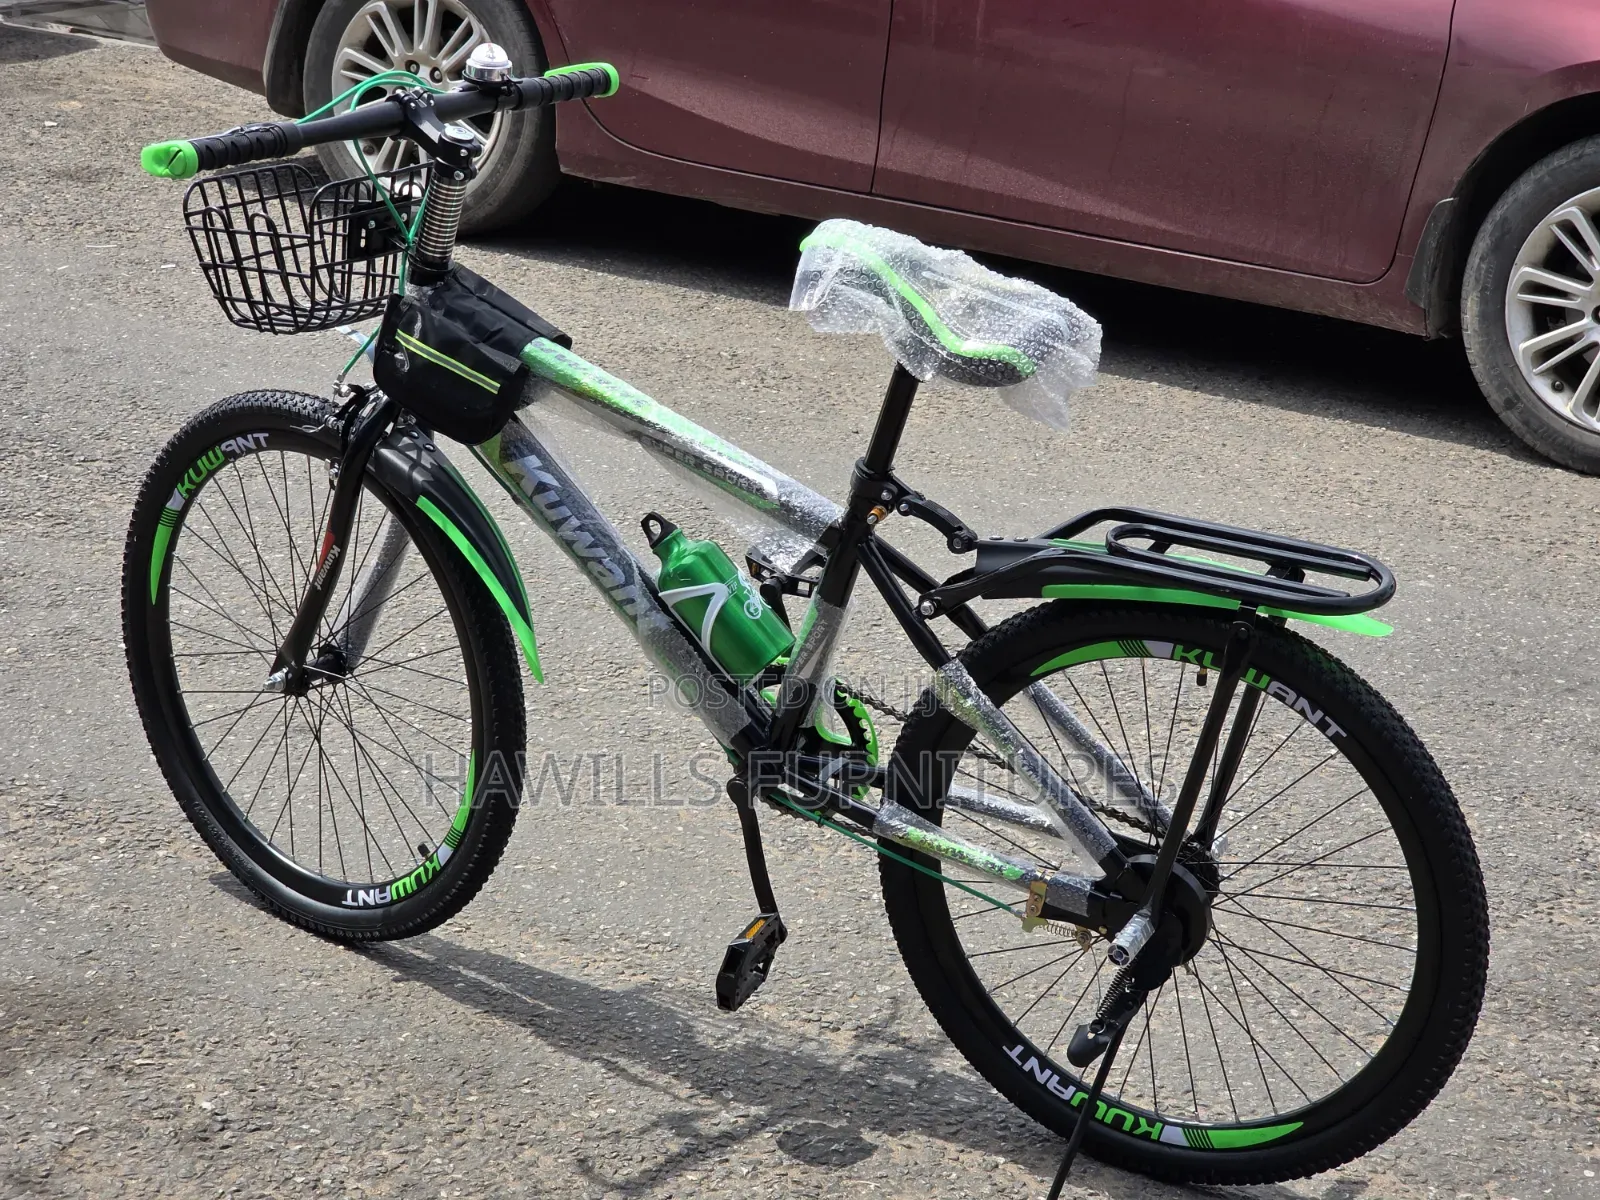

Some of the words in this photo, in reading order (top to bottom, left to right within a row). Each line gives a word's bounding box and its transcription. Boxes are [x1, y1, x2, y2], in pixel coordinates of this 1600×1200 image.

[177, 432, 269, 499] KUWANT
[314, 544, 341, 591] Kuwant
[341, 852, 441, 907] KUWANT
